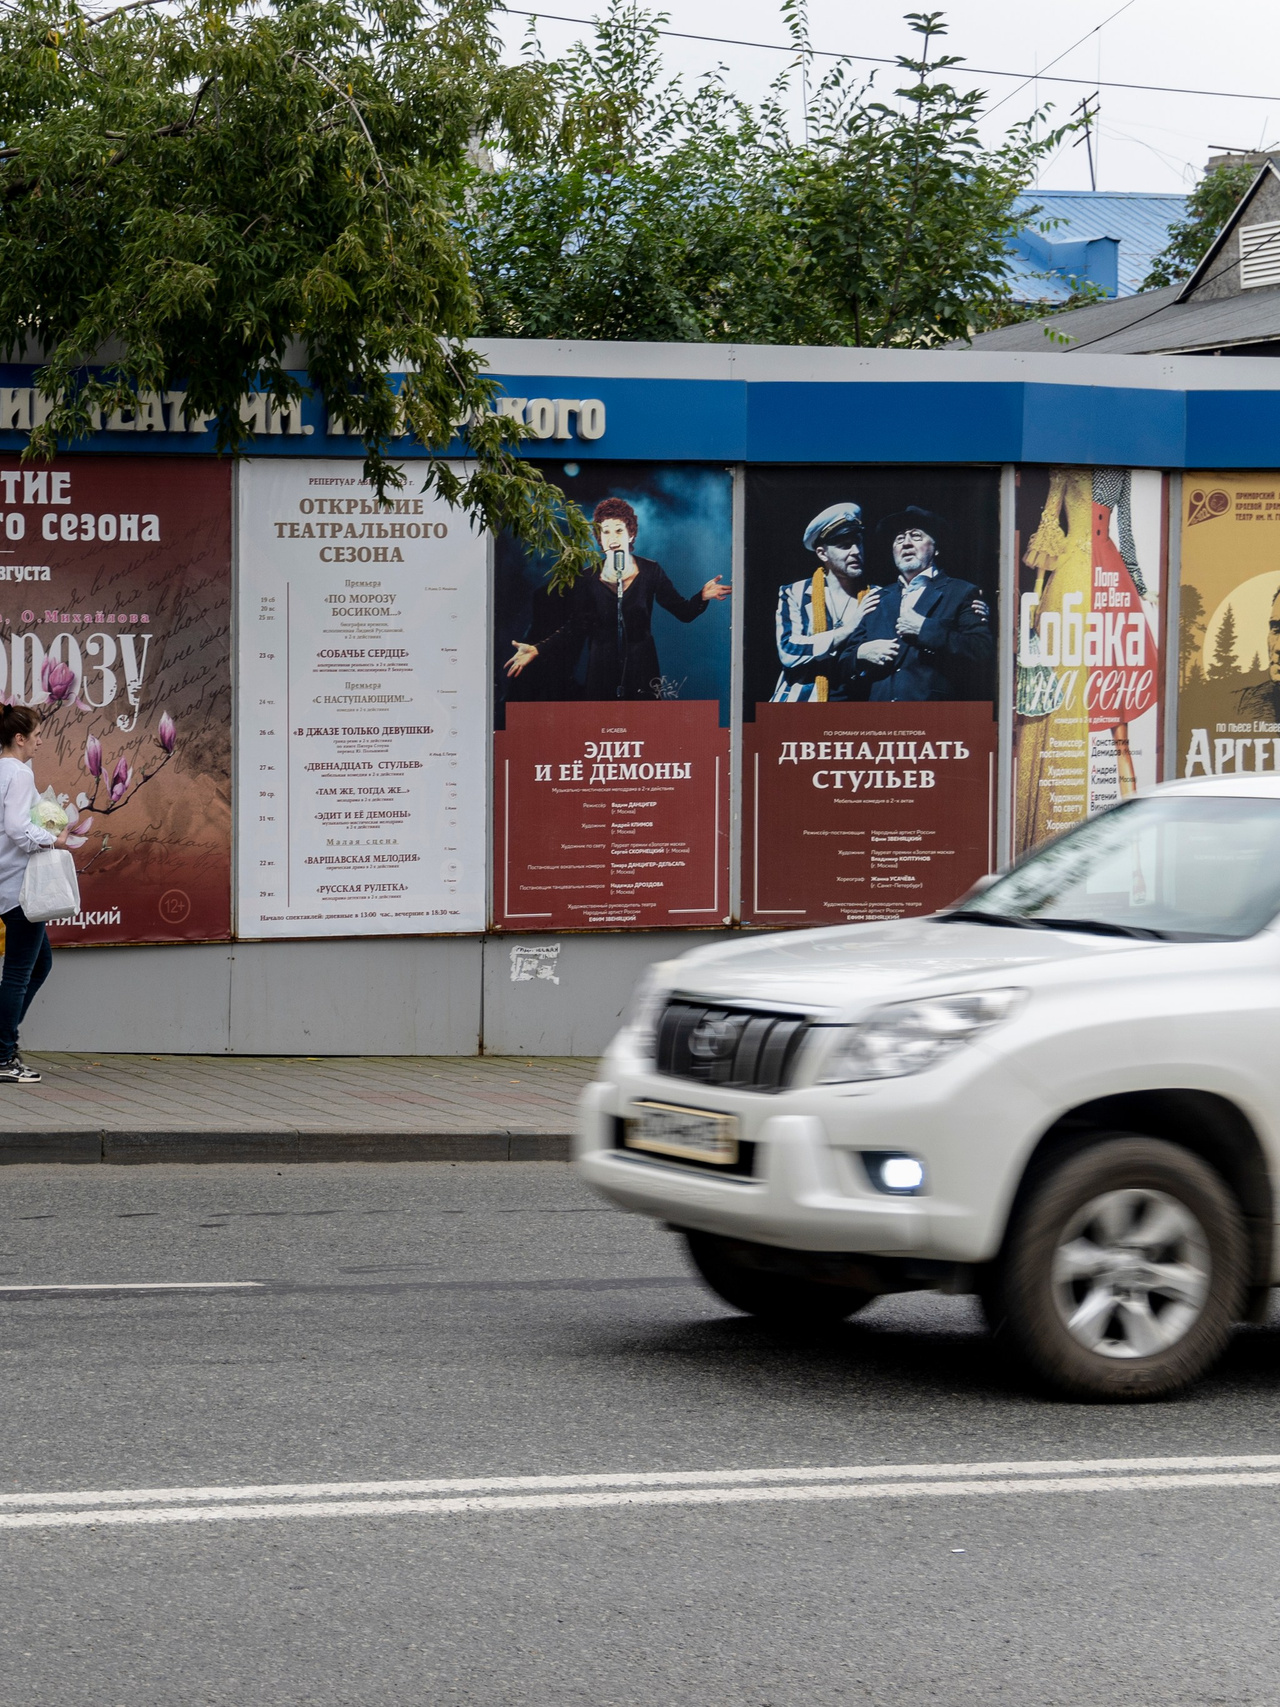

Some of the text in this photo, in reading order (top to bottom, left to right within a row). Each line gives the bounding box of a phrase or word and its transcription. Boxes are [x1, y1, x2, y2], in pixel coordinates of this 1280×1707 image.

[309, 478, 355, 486] РЕПЕРТУАР
[1235, 502, 1262, 510] КРАЕВОЙ
[41, 512, 160, 542] сезона
[274, 522, 448, 539] ТЕАТРАЛЬНОГО
[319, 547, 404, 563] СЕЗОНА
[1094, 567, 1119, 587] Лопе
[345, 579, 381, 587] Премьера
[324, 594, 396, 605] «ПО МОРОЗУ
[1094, 587, 1130, 609] де Вега
[20, 608, 150, 624] О.Михайлова
[332, 607, 401, 616] БОСИКОМ...»
[1020, 591, 1145, 667] Собака
[317, 649, 409, 659] «СОБАЧЬЕ СЕРДЦЕ»
[1030, 670, 1153, 711] на сене
[312, 696, 321, 704] «С
[293, 725, 434, 737] «В ДЖАЗЕ ТОЛЬКО ДЕВУШКИ»
[1216, 723, 1226, 732] по
[1228, 723, 1252, 732] пьесе
[1092, 737, 1129, 747] Константин
[584, 741, 644, 762] ЭДИТ
[778, 741, 970, 765] ДВЕНАДЦАТЬ
[1091, 747, 1121, 757] Демидов
[303, 761, 423, 772] «ДВЕНАДЦАТЬ СТУЛЬЕВ»
[1092, 765, 1117, 775] Андрей
[535, 760, 692, 785] И ЕЁ ДЕМОНЫ
[812, 770, 936, 792] СТУЛЬЕВ
[1091, 775, 1116, 784] Климов
[315, 786, 410, 796] «ТАМ ЖЕ, ТОГДА ЖЕ...»
[1091, 791, 1117, 801] Евгений
[314, 812, 341, 821] «ЭДИТ
[353, 809, 364, 819] ЕЁ
[366, 810, 411, 820] ДЕМОНЫ»
[326, 838, 360, 846] Малая
[304, 853, 420, 865] «ВАРШАВСКАЯ МЕЛОДИЯ»
[316, 884, 408, 895] «РУССКАЯ РУЛЕТКА»
[164, 899, 185, 913] 12+
